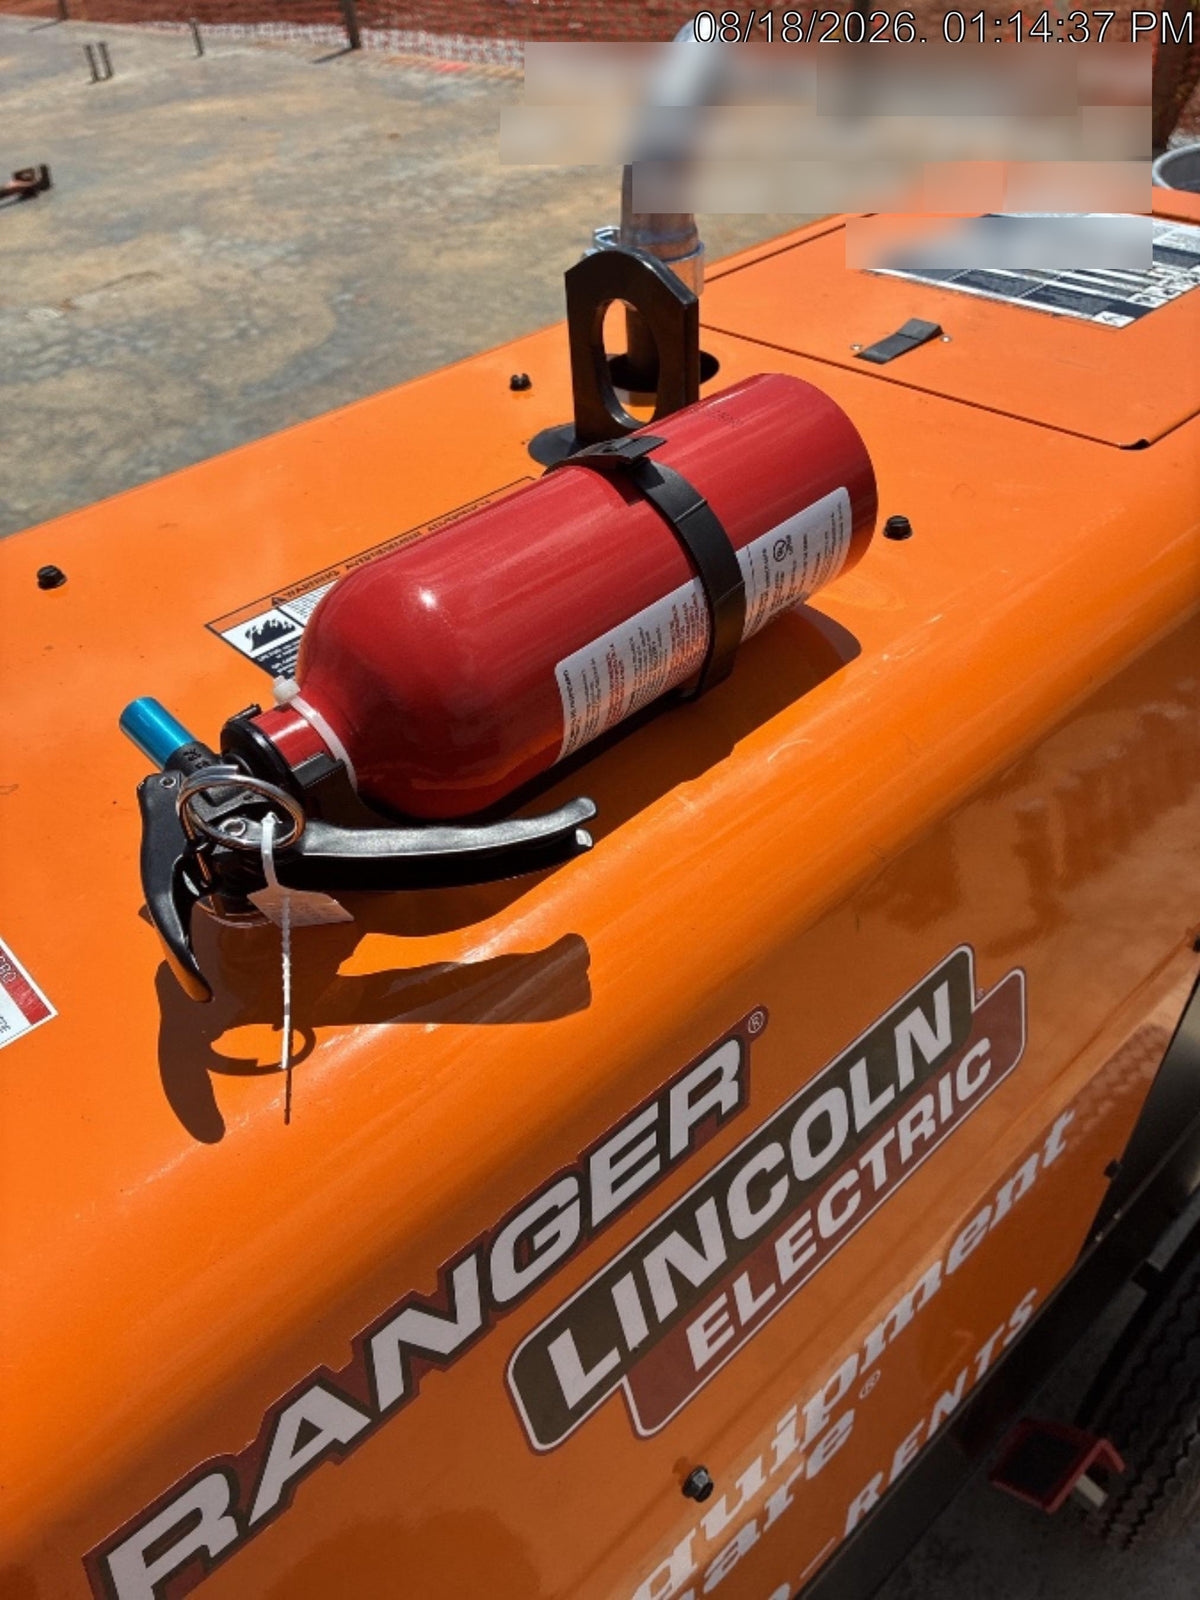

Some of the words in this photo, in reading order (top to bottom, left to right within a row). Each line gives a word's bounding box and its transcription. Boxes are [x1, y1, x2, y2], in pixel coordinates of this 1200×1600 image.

[546, 979, 952, 1411] LINCOLN
[685, 1036, 992, 1372] ELECTRIC
[679, 1409, 854, 1600] are
